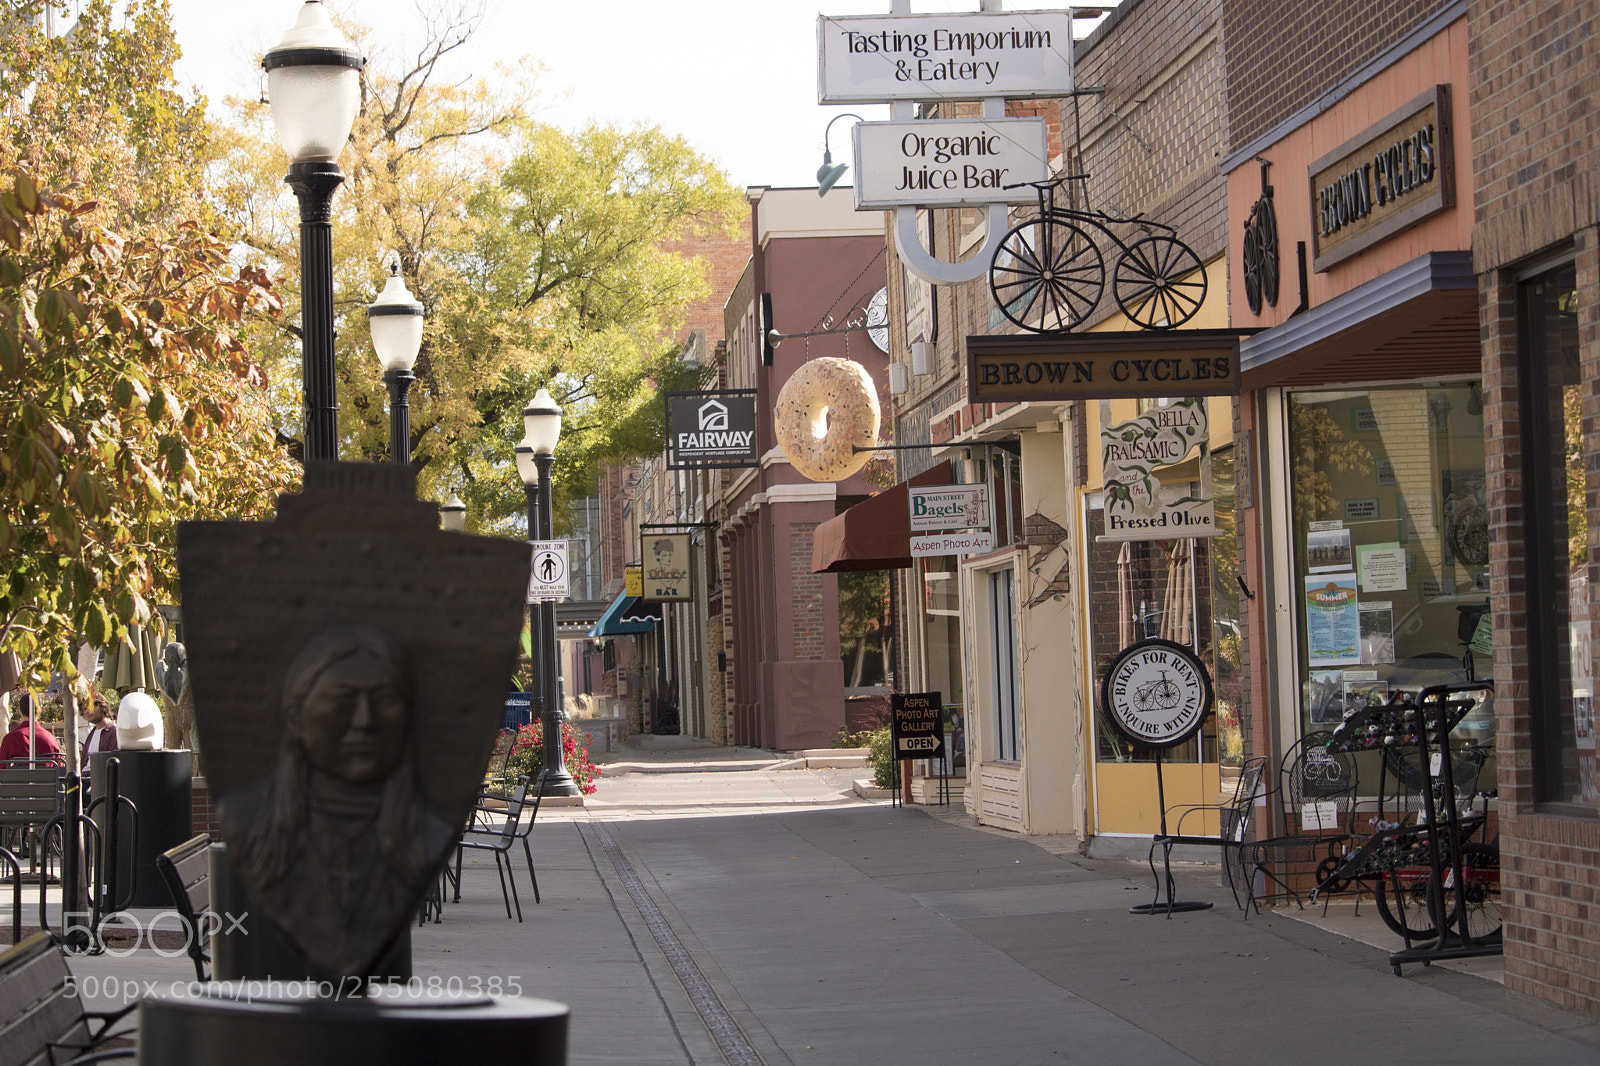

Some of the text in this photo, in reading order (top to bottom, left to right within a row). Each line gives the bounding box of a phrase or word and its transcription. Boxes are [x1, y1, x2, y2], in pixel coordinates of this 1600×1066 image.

[842, 27, 1051, 58] Tasting Emporium
[895, 58, 1000, 85] & Eatery
[901, 131, 1001, 163] Organic
[894, 165, 1009, 191] Juice Bar
[1319, 124, 1434, 238] BROWN CYCLES
[980, 357, 1230, 386] BROWN CYCLES
[1158, 410, 1199, 428] BELLA
[678, 430, 754, 449] FAIRWAY
[1109, 441, 1179, 461] BALSAMIC
[1119, 471, 1138, 482] and
[1132, 485, 1146, 495] the
[912, 495, 964, 518] Bagels
[1110, 510, 1211, 530] Pressed Olive
[913, 538, 989, 551] Aspen Photo Art
[656, 588, 678, 596] BAR
[1316, 592, 1348, 601] SUMMER
[1115, 652, 1198, 696] BIKES FOR RENT
[903, 698, 930, 708] ASPEN
[896, 708, 939, 720] PHOTO ART
[1118, 696, 1197, 734] INQUIRE WITHIN
[901, 721, 936, 732] GALLERY
[907, 738, 934, 749] OPEN
